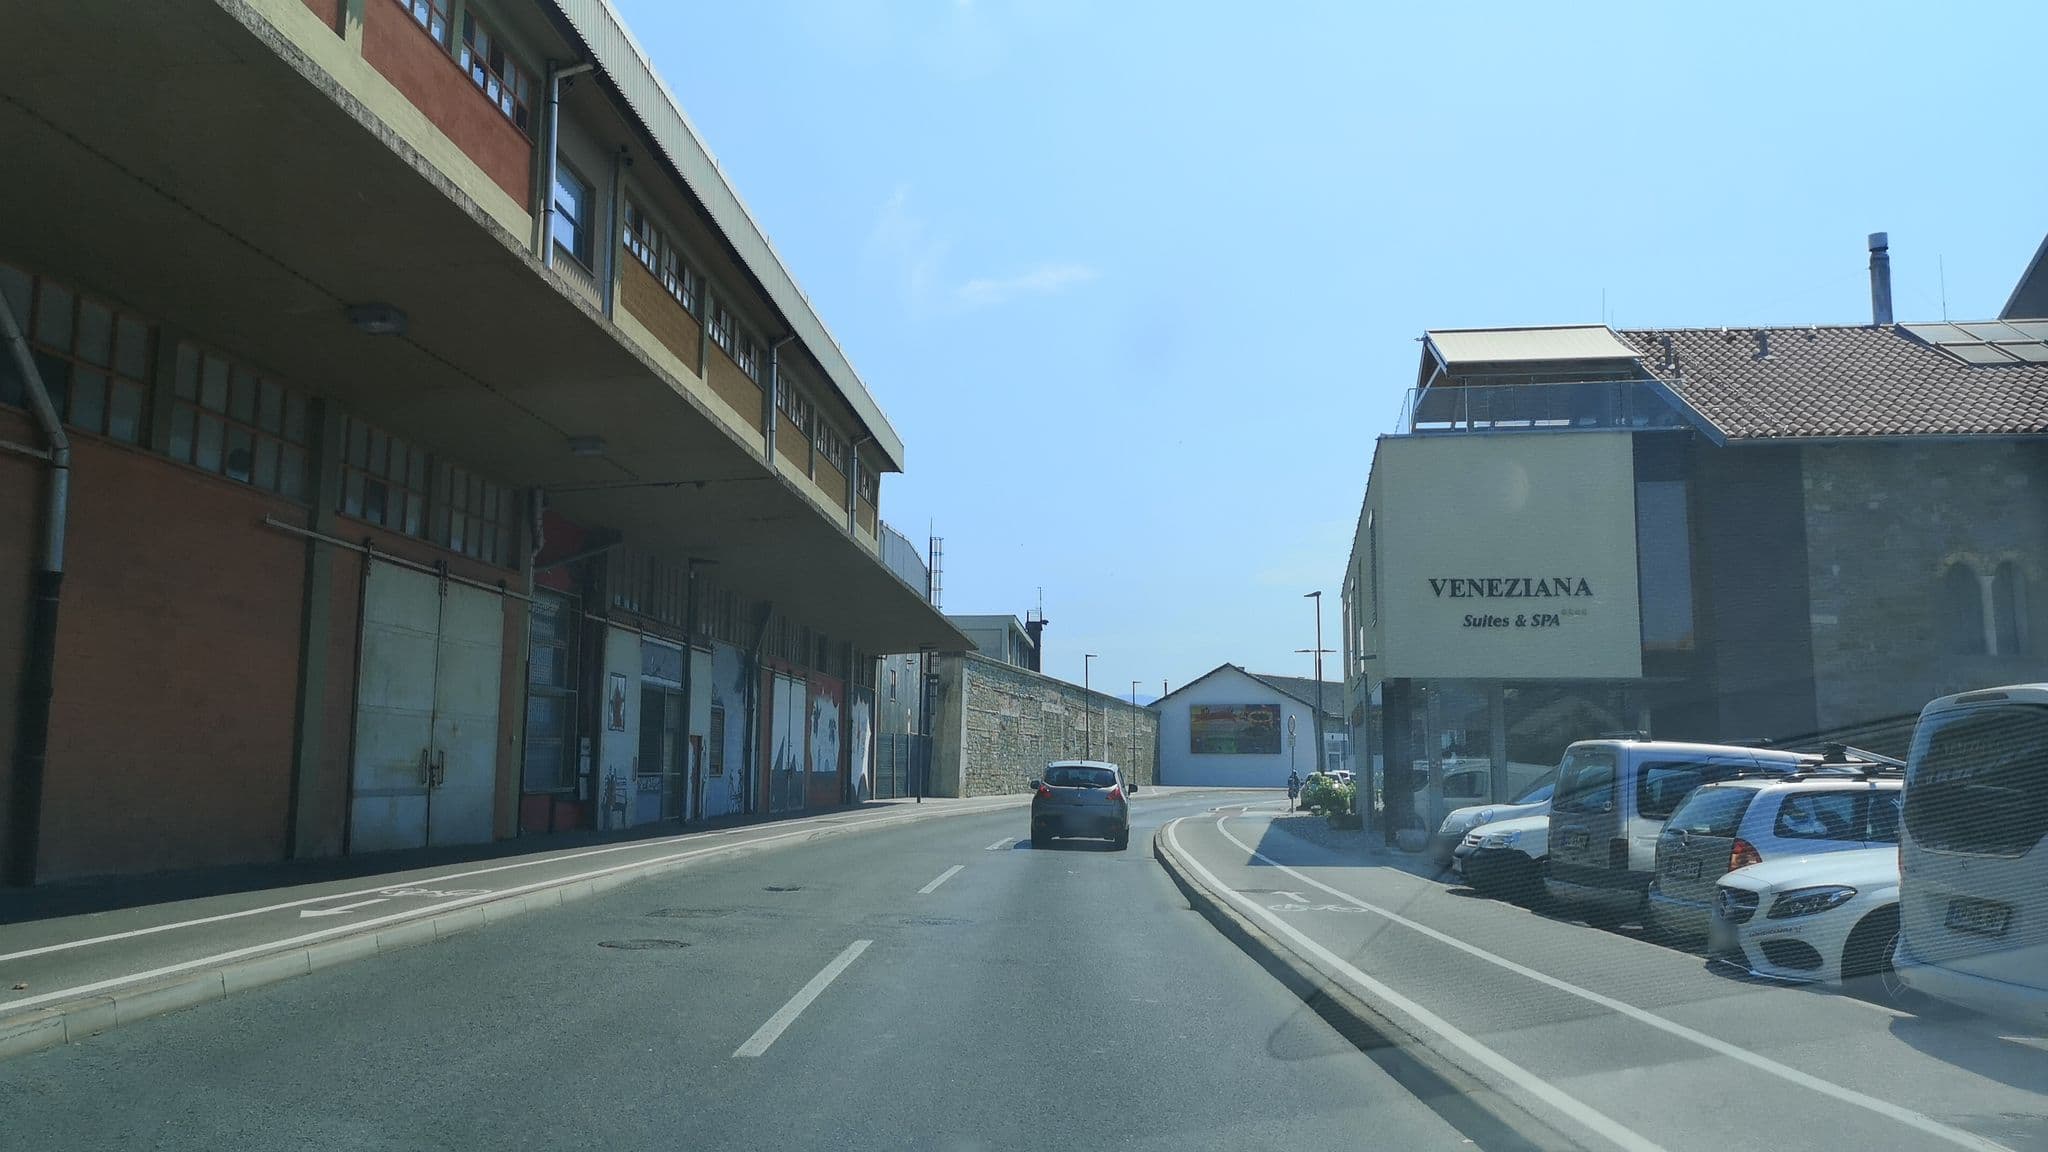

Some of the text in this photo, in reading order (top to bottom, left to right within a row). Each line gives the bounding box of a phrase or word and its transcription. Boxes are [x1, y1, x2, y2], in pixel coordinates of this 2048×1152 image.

[1428, 577, 1593, 598] VENEZIANA
[1463, 614, 1560, 627] Suites & SPA
